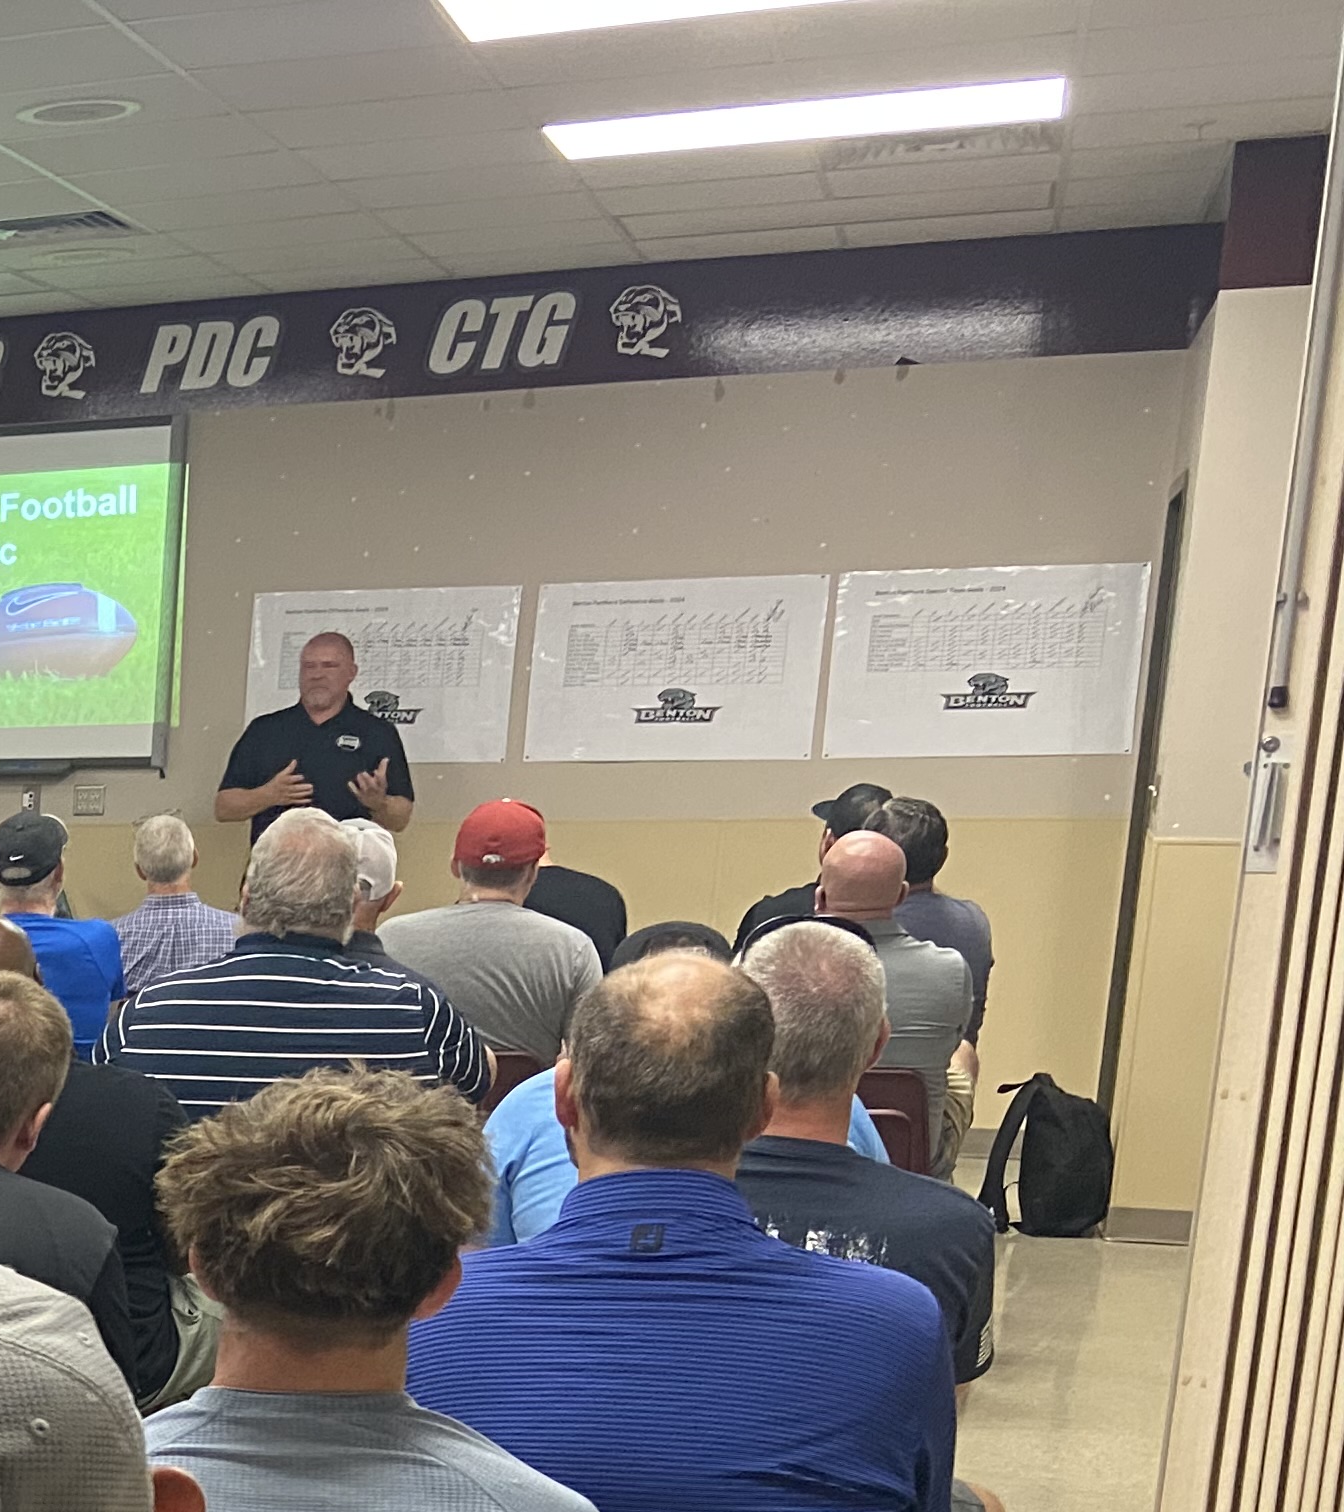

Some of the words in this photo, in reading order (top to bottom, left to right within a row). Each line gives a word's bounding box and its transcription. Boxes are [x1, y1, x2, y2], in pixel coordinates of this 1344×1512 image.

[427, 291, 577, 374] CTG
[139, 315, 281, 394] PDC
[0, 484, 138, 523] Football
[639, 708, 713, 720] BENTON
[948, 694, 1027, 707] BENTON
